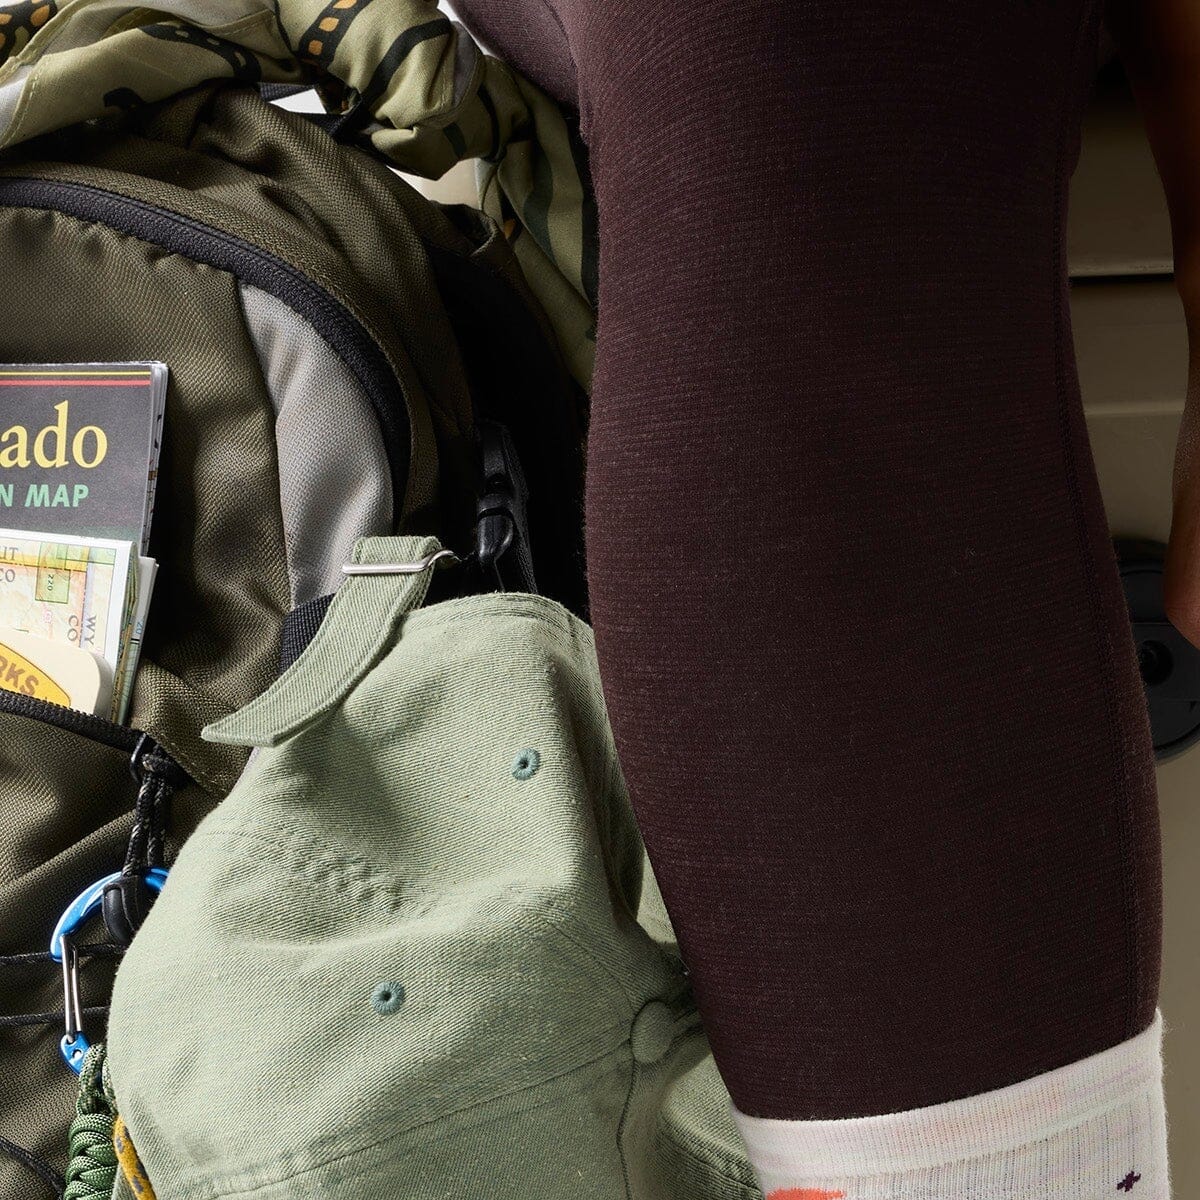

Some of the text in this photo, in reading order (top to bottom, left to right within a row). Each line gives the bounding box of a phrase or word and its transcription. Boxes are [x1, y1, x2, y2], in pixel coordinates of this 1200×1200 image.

[0, 400, 108, 468] ado
[24, 484, 89, 508] MAP
[67, 614, 79, 642] CO
[84, 615, 97, 646] WY
